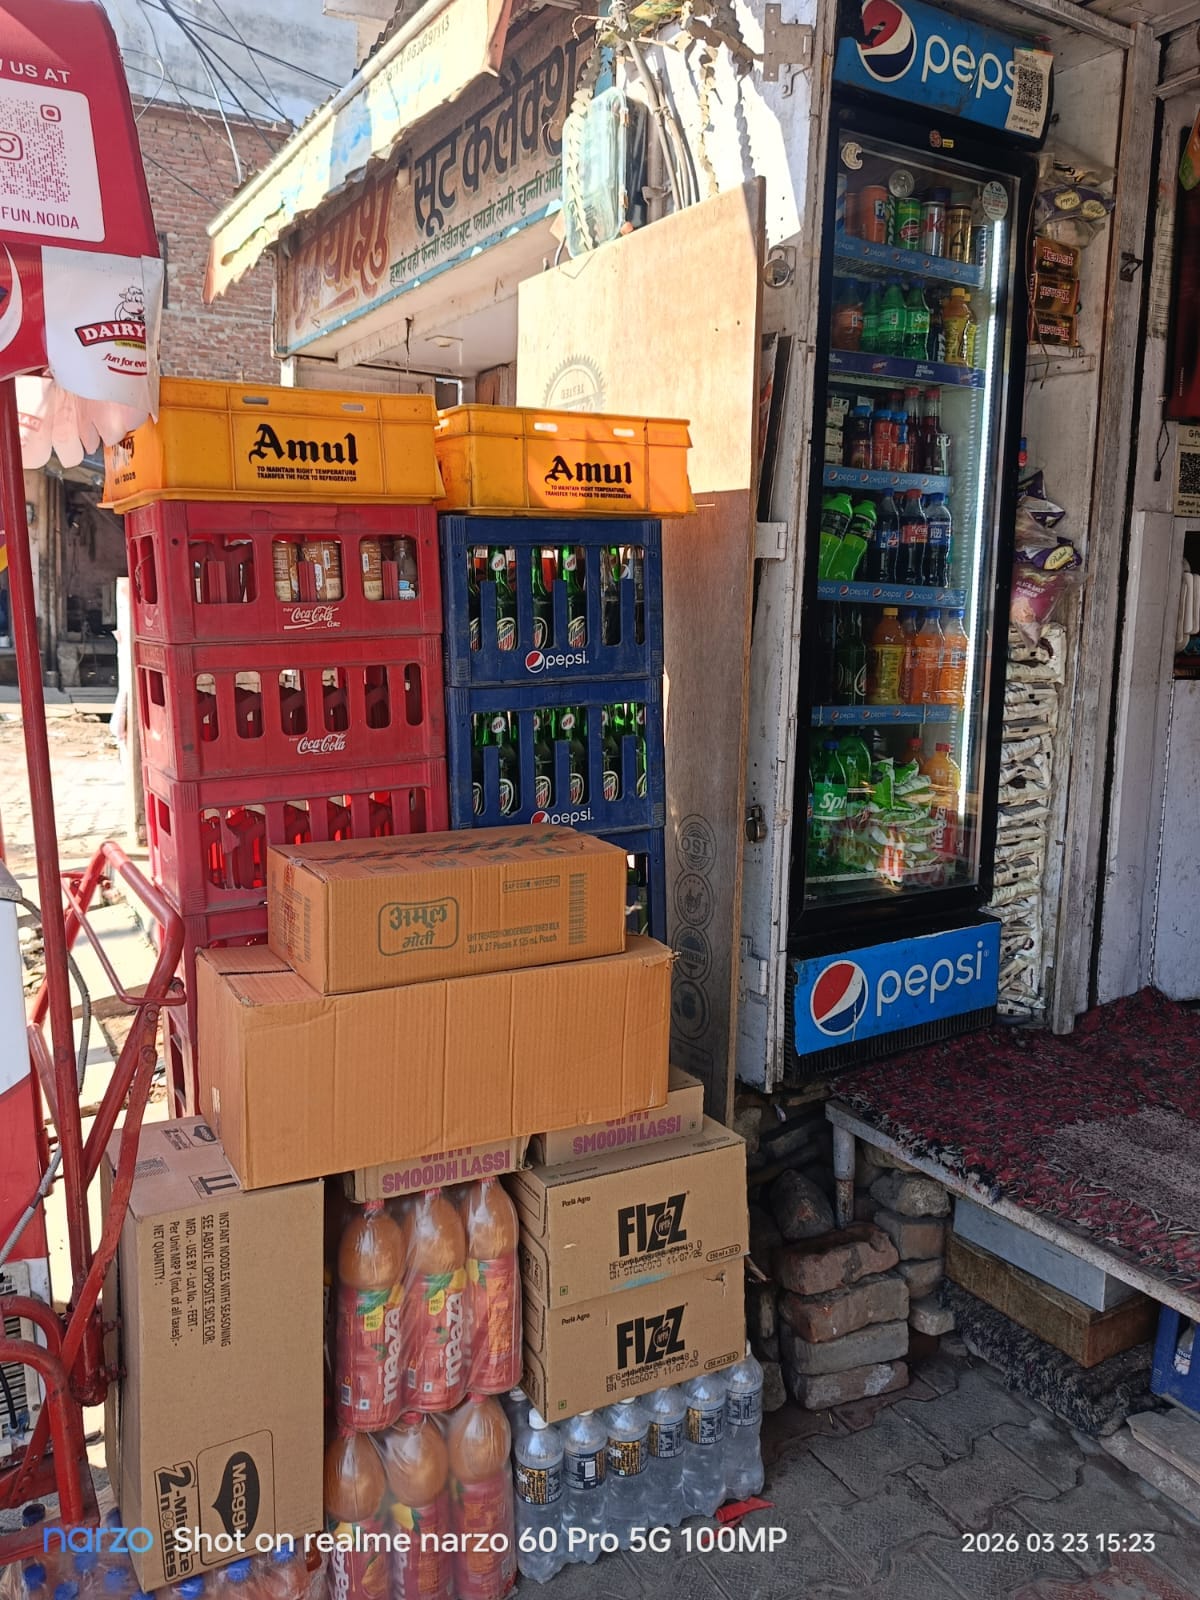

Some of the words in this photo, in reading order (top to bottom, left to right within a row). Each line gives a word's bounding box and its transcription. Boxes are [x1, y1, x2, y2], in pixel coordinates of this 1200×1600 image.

[9, 60, 38, 78] US
[44, 67, 71, 84] AT
[921, 34, 1015, 99] peps
[462, 28, 595, 192] कलेक्श
[83, 323, 146, 341] DAIRY
[102, 352, 120, 364] fun
[120, 356, 134, 368] for
[248, 423, 359, 465] Amul
[257, 472, 285, 480] TRANSFER
[315, 468, 356, 476] TEMPERATURE
[544, 455, 632, 485] Amul
[291, 605, 339, 624] Coca-Cola
[546, 651, 586, 669] pepsi
[297, 733, 346, 755] Coca-Cola
[551, 807, 592, 825] pepsi
[388, 904, 448, 931] अमूल
[402, 928, 435, 948] मोती
[876, 940, 984, 1017] pepsi
[573, 1126, 637, 1155] SMOODH
[639, 1115, 682, 1141] LASSI
[382, 1162, 458, 1194] SMOODH
[461, 1150, 511, 1178] LASSI
[153, 1224, 165, 1240] NET
[169, 1221, 180, 1234] Per
[203, 1214, 214, 1230] SEE
[219, 1211, 230, 1244] INSTANT
[617, 1192, 687, 1258] FIZZ
[170, 1235, 181, 1252] Unit
[186, 1243, 197, 1260] USE
[203, 1231, 214, 1259] ABOVE
[152, 1241, 165, 1280] QUANTITY
[170, 1252, 181, 1270] MRP
[186, 1260, 197, 1270] BY
[220, 1245, 230, 1282] NOODLES
[186, 1276, 197, 1290] Lot
[203, 1266, 215, 1305] OPPOSITE
[220, 1282, 231, 1303] WITH
[171, 1297, 182, 1305] of
[187, 1290, 197, 1304] No.
[171, 1306, 183, 1317] all
[204, 1306, 216, 1326] SIDE
[220, 1303, 231, 1347] SEASONING
[445, 1292, 463, 1388] maaza
[616, 1303, 686, 1370] FIZZ
[383, 1306, 401, 1405] maaza
